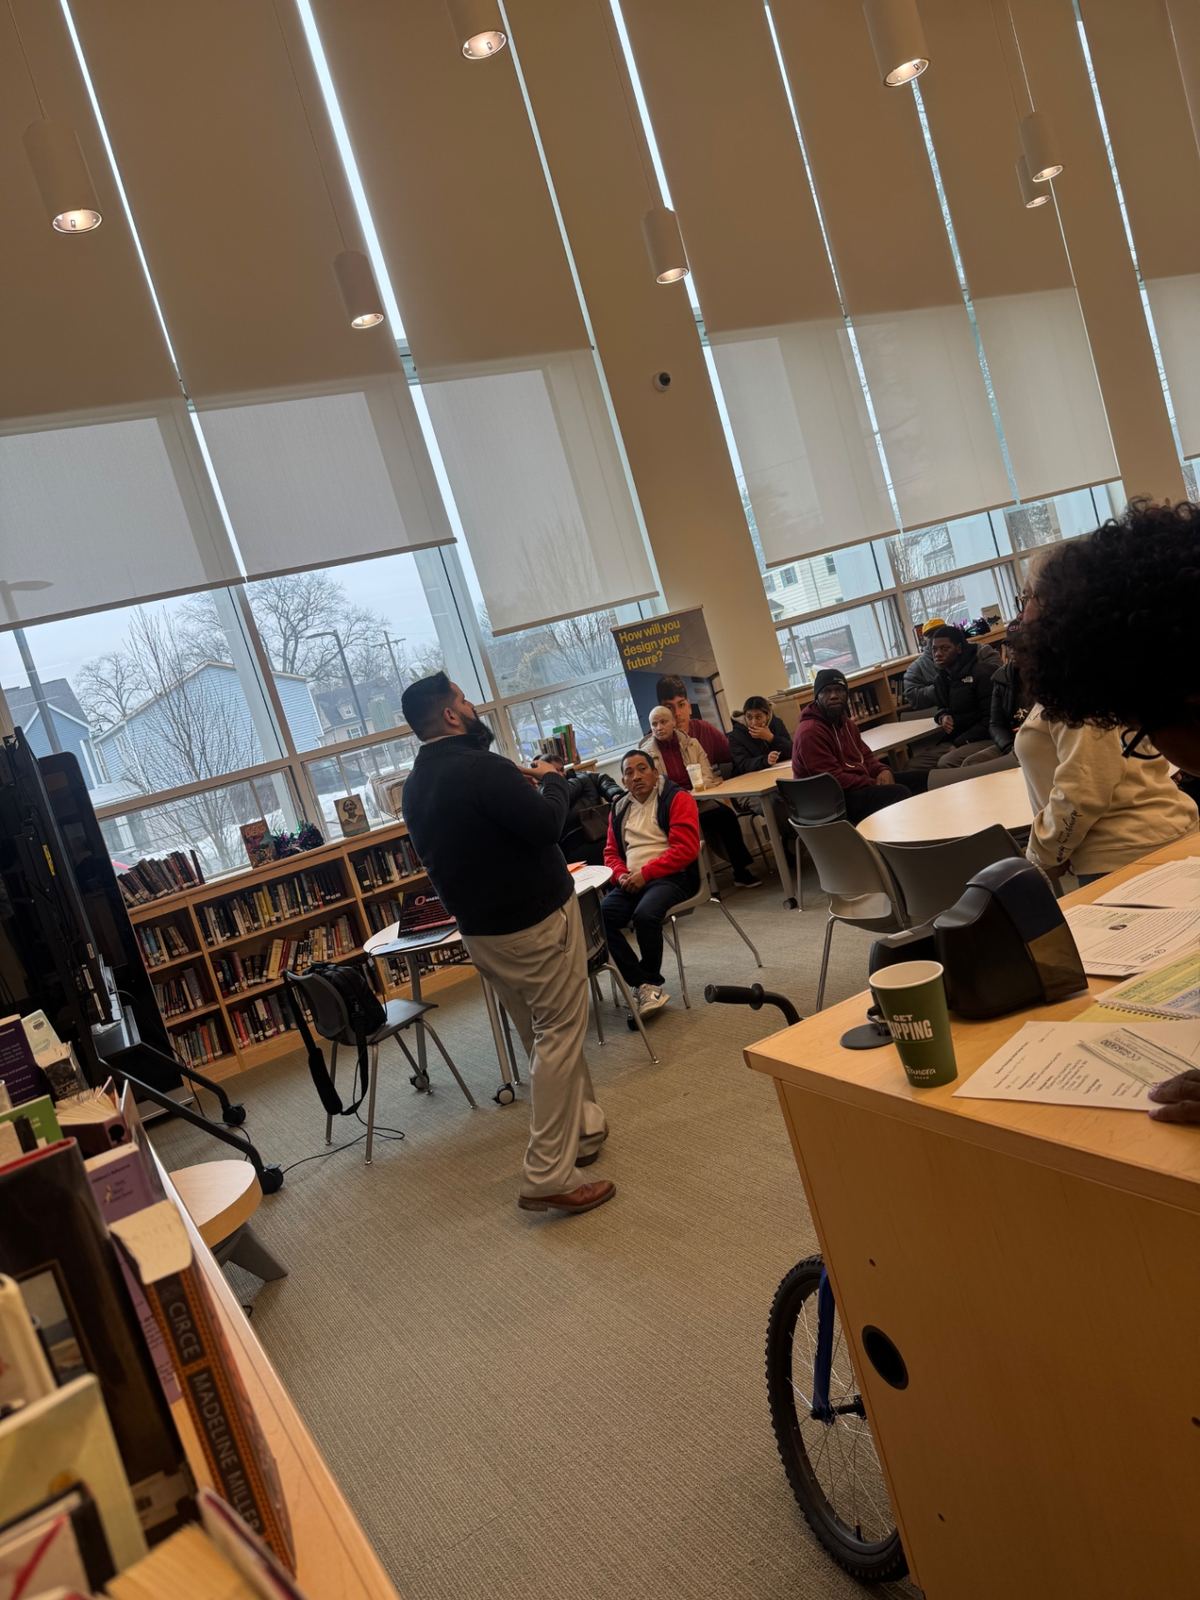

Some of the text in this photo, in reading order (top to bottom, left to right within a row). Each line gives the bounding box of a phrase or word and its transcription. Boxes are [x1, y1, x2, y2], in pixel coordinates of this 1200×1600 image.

[618, 620, 680, 644] How will you
[623, 634, 680, 657] design your
[626, 650, 663, 670] future?
[893, 1014, 913, 1022] GET
[168, 1301, 202, 1362] CIRCE
[193, 1372, 262, 1535] MADELINE MILLER
